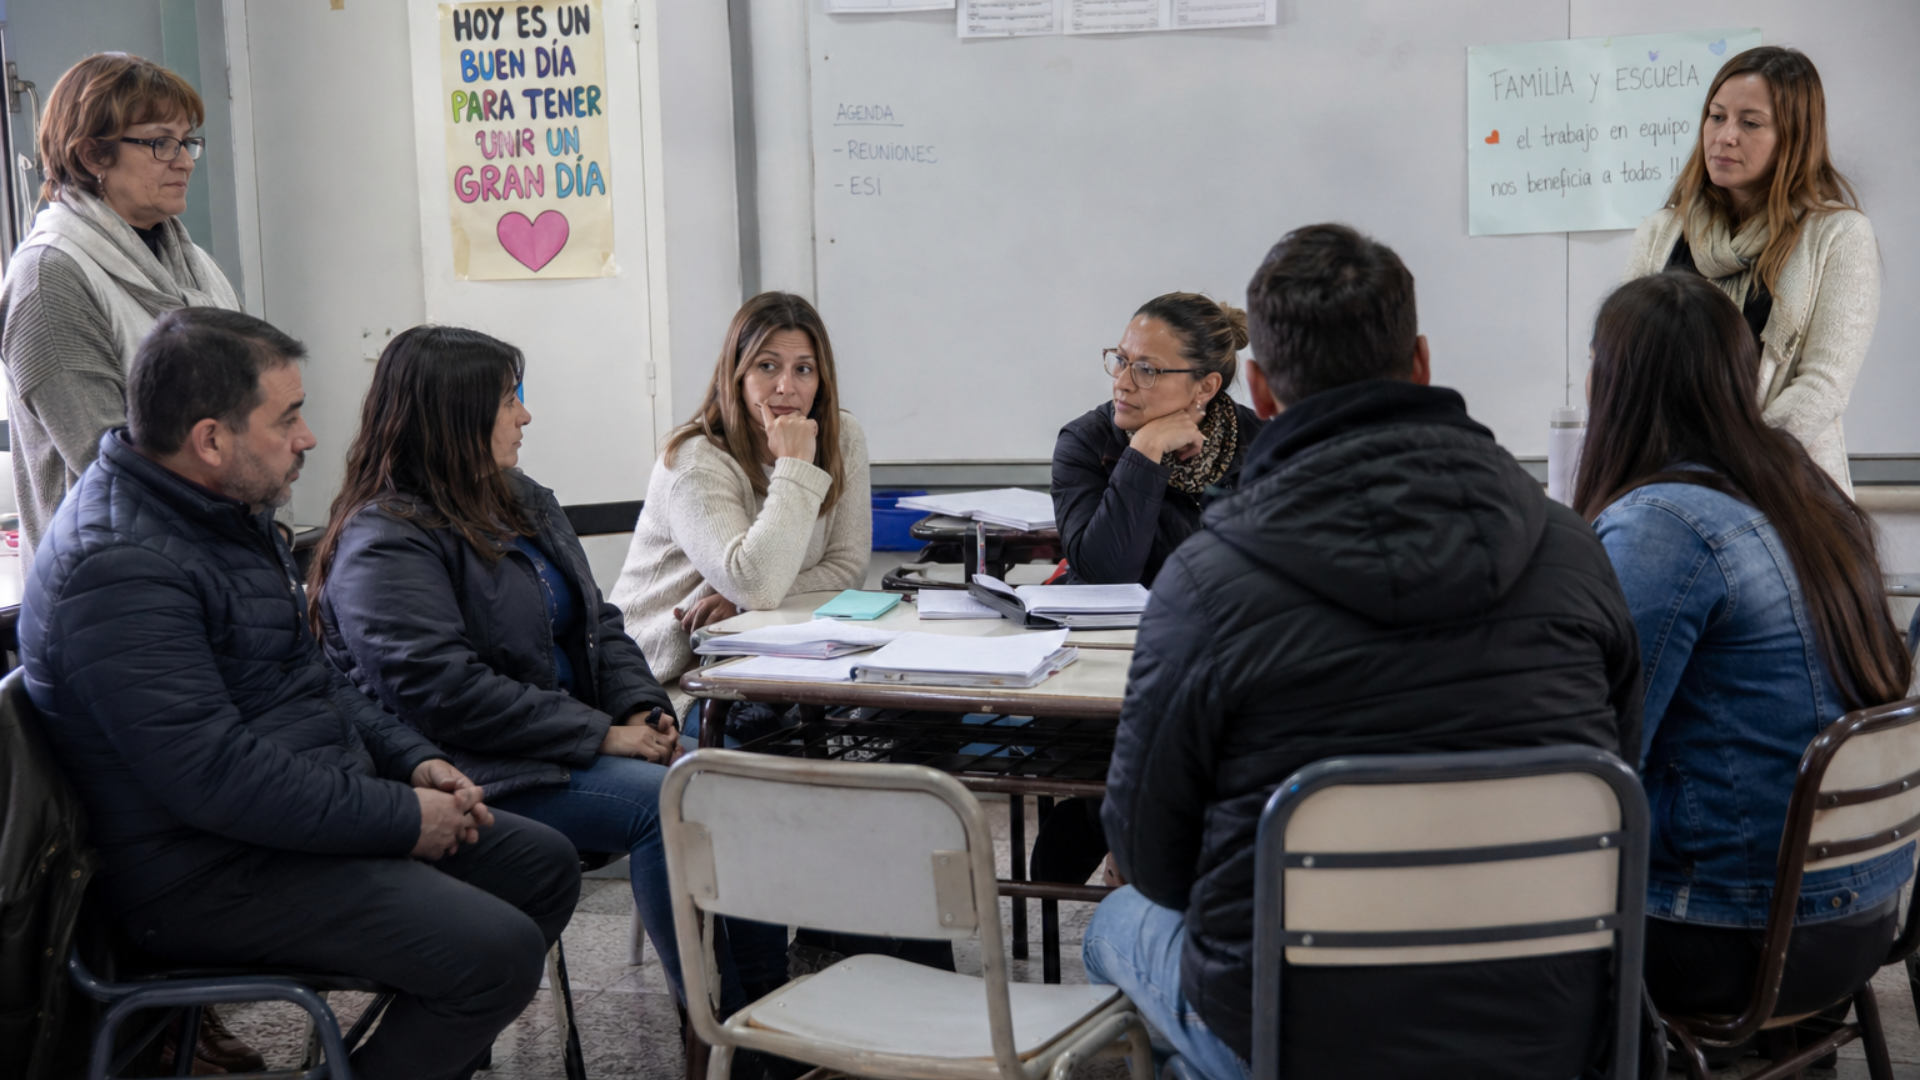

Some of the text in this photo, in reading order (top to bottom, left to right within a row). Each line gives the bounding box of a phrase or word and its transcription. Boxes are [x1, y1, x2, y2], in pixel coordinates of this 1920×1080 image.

[453, 4, 590, 42] HOY ES UN
[460, 38, 576, 83] BUEN DÍA
[451, 85, 602, 123] PARA TENER
[836, 103, 895, 121] AGENDA
[475, 125, 580, 160] UNIR UN
[1517, 117, 1690, 152] el trabajo en equipo
[454, 154, 606, 204] GRAN DÍA
[1491, 181, 1517, 197] nos
[1527, 167, 1592, 198] beneficia
[1602, 169, 1612, 184] a
[1620, 160, 1662, 183] todos
